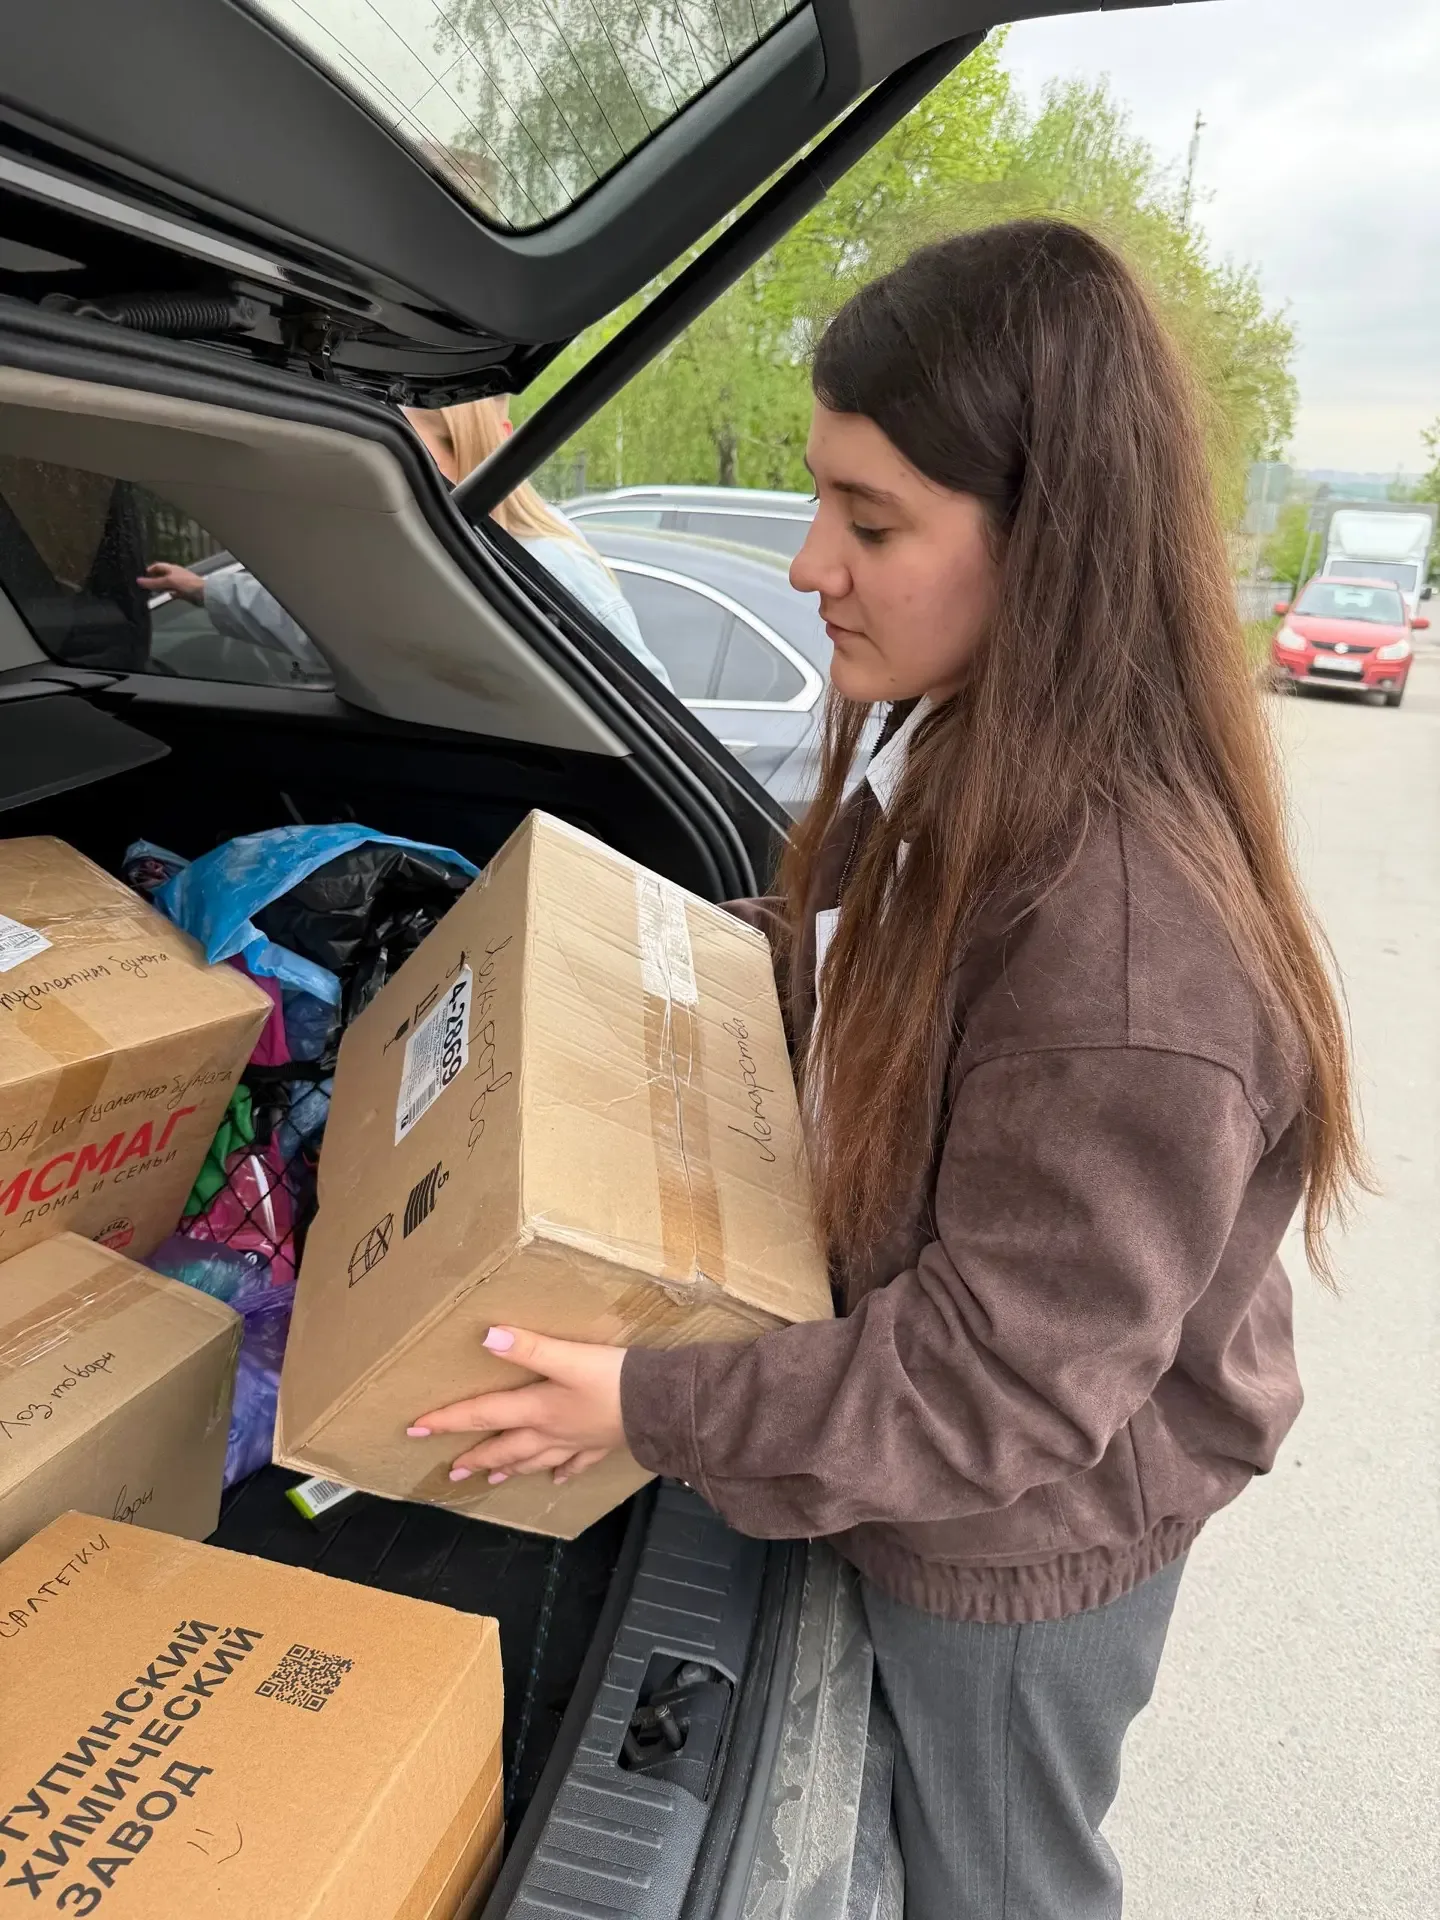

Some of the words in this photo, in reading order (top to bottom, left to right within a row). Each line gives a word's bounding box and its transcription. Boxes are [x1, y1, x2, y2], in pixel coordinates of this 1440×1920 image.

[441, 980, 467, 1087] 4-2869
[19, 1190, 80, 1228] ДОМА
[91, 1179, 105, 1194] И
[113, 1149, 177, 1184] СЕМЬИ
[0, 1619, 219, 1868] ТУПИНСКИЙ
[3, 1626, 265, 1901] ХИМИЧЕСКИЙ
[56, 1760, 215, 1918] ЗАВОД
